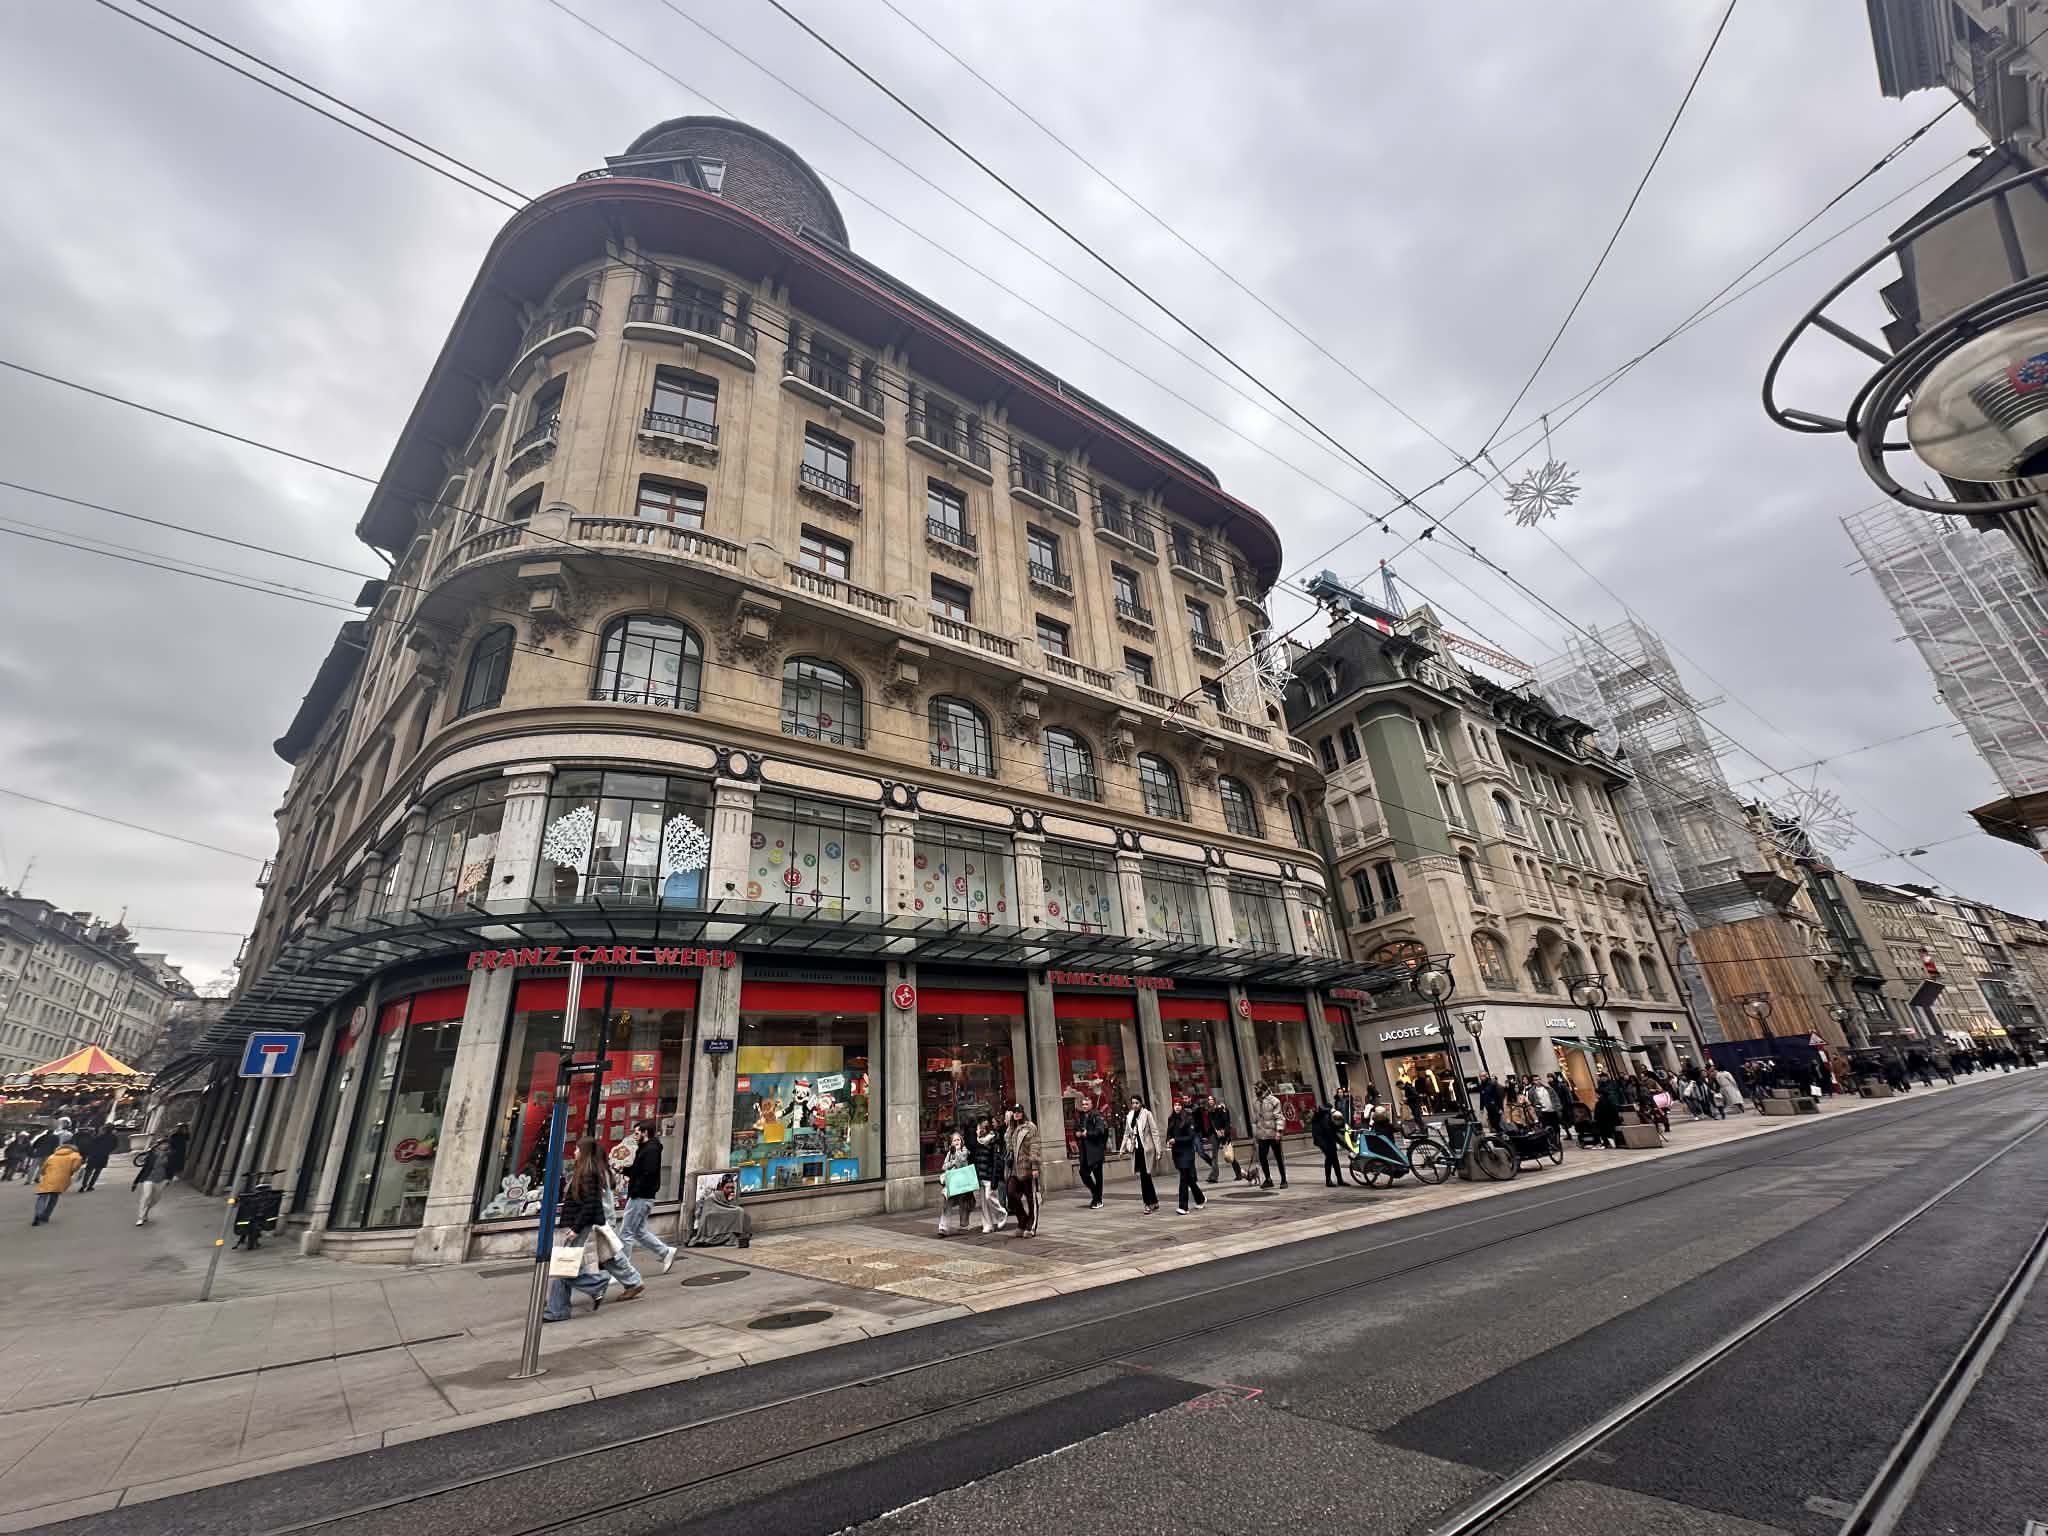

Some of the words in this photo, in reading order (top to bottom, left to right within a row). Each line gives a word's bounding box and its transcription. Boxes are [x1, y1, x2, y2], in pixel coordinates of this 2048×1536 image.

[468, 946, 562, 969] FRANZ
[572, 946, 641, 965] CARL
[654, 947, 737, 968] WEBER
[1047, 970, 1097, 985] FRANZ
[1379, 1027, 1421, 1041] LACOSTE
